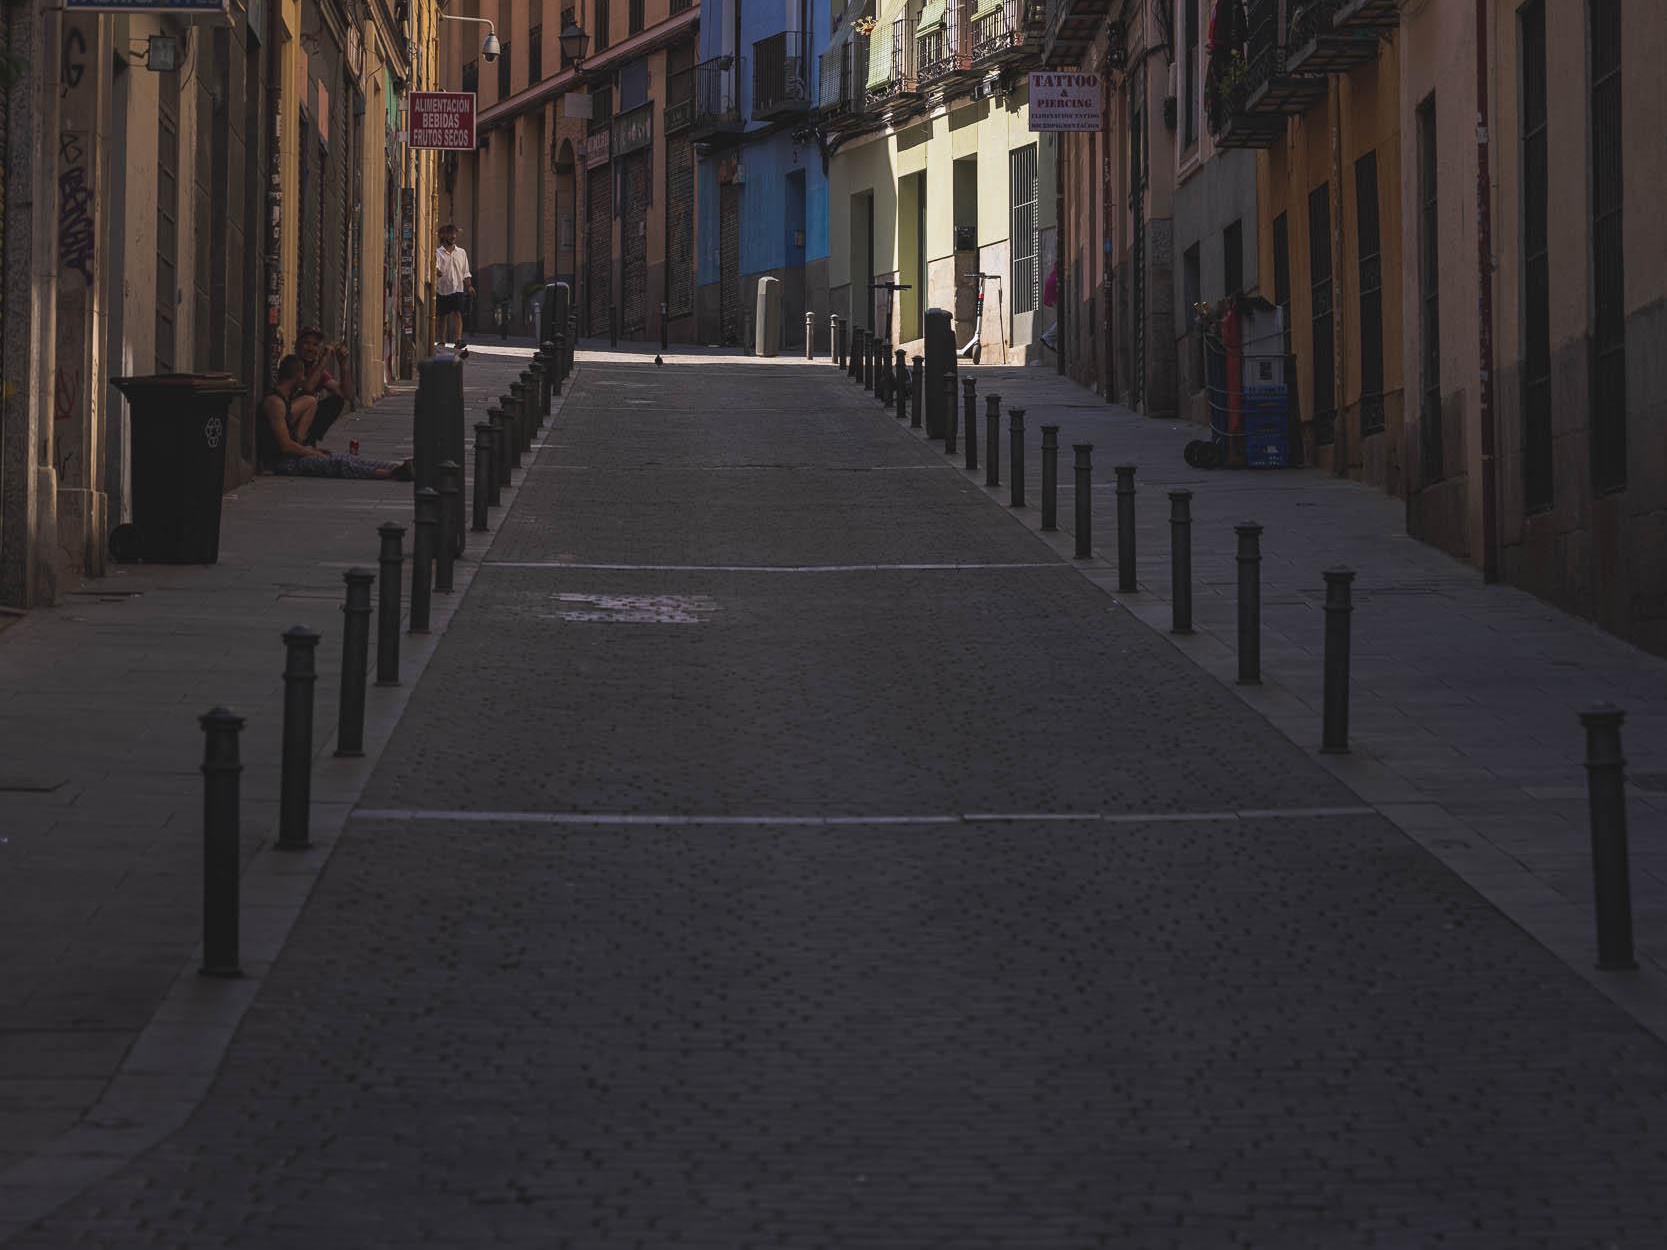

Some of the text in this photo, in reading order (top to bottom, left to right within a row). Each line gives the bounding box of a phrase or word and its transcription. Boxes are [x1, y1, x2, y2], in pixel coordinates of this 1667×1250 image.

[1032, 74, 1098, 87] TATTOO
[1060, 89, 1068, 97] &
[1037, 99, 1092, 108] PIERCING
[422, 113, 460, 128] BEBIDAS
[413, 129, 469, 146] FRUTOS SECOS
